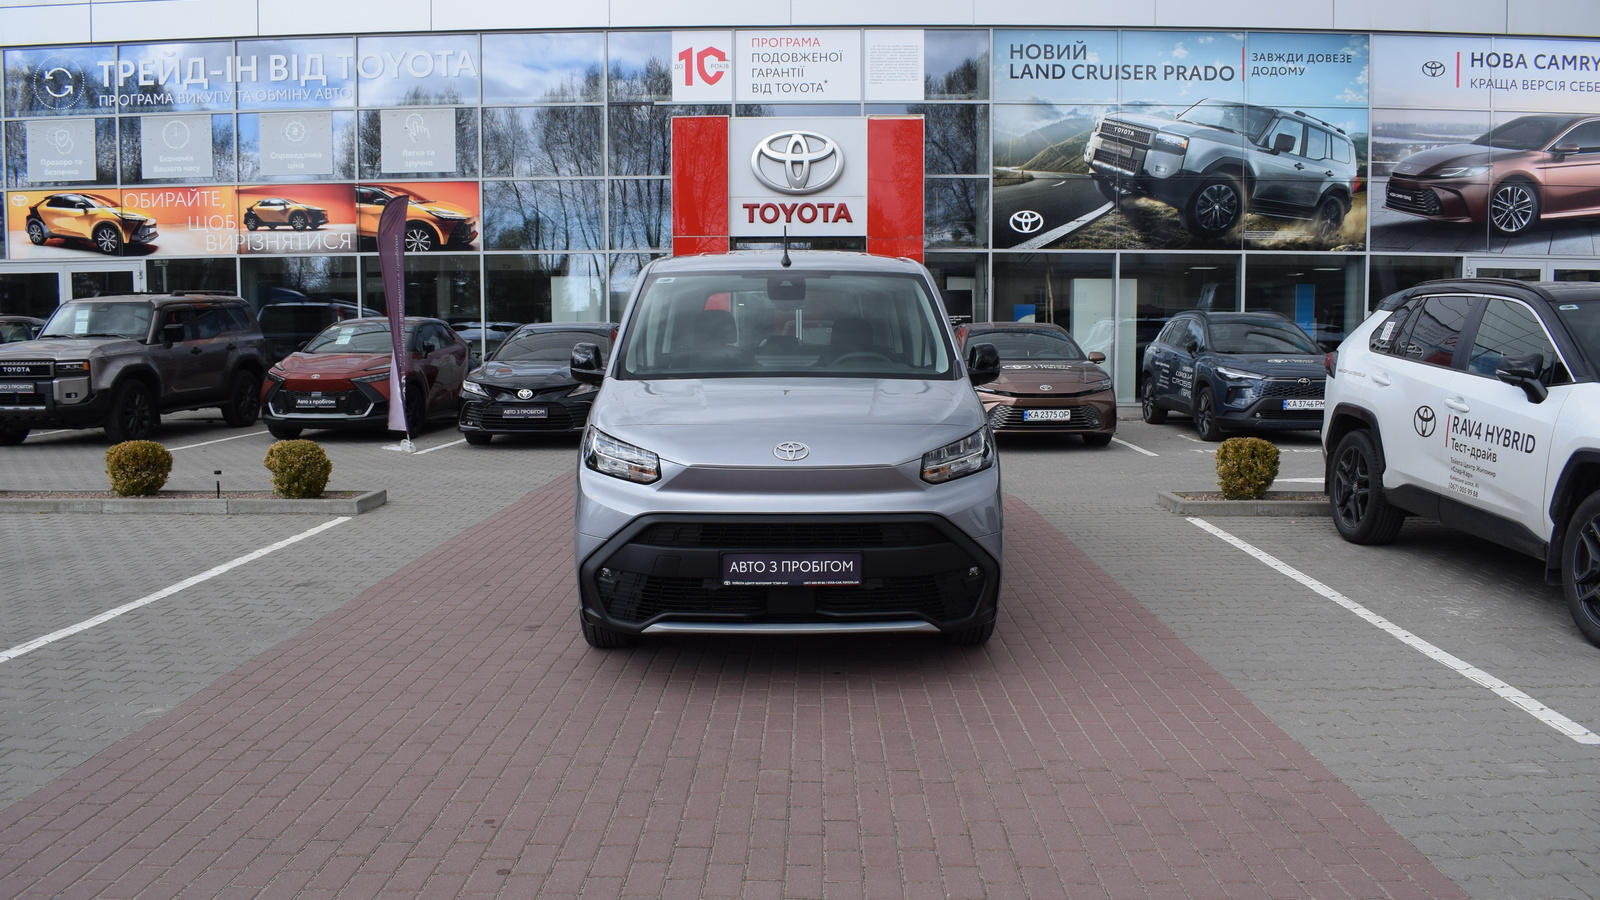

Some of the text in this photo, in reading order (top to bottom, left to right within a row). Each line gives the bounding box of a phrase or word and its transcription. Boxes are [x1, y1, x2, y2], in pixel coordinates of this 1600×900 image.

[751, 37, 820, 48] ПРОГРАМА
[1010, 40, 1087, 60] НОВИЙ
[751, 50, 843, 64] ПОДОВЖЕНОЇ
[1252, 53, 1353, 64] ЗАВЖДИ ДОВЕЗЕ
[1470, 52, 1600, 72] НОВА CAMRY
[97, 50, 478, 91] ТРЕЙД-ІН ВІД TOYOTA
[751, 65, 804, 78] ГАРАНТІЇ
[1009, 63, 1235, 81] LAND CRUISER PRADO
[1251, 66, 1306, 77] ДОДОМУ
[752, 83, 772, 95] ВІД
[1470, 78, 1600, 93] КРАЩА ВЕРСІЯ СЕБЕ
[99, 87, 352, 106] ПРОГРАМА ВИКУПУ ТА ОБМІНУ АВТО
[1114, 126, 1135, 136] TOYOTA
[270, 152, 322, 160] Справедлива
[402, 149, 423, 157] Легко
[40, 158, 73, 167] Прозоро
[153, 165, 200, 173] Вашого часу
[287, 162, 304, 170] ціна
[44, 167, 79, 175] безпечно
[123, 188, 226, 208] ОБИРАЙТЕ,
[743, 203, 853, 223] TOYOTA
[188, 214, 235, 232] ЩОБ
[206, 233, 352, 252] ВИРІЗНЯТИСЯ
[1298, 400, 1314, 408] 3746
[1040, 410, 1058, 418] 2375
[1451, 415, 1536, 454] RAV4 HYBRID
[1451, 437, 1498, 463] Тест-драйв
[729, 560, 853, 573] АВТО З ПРОБІГОМ
